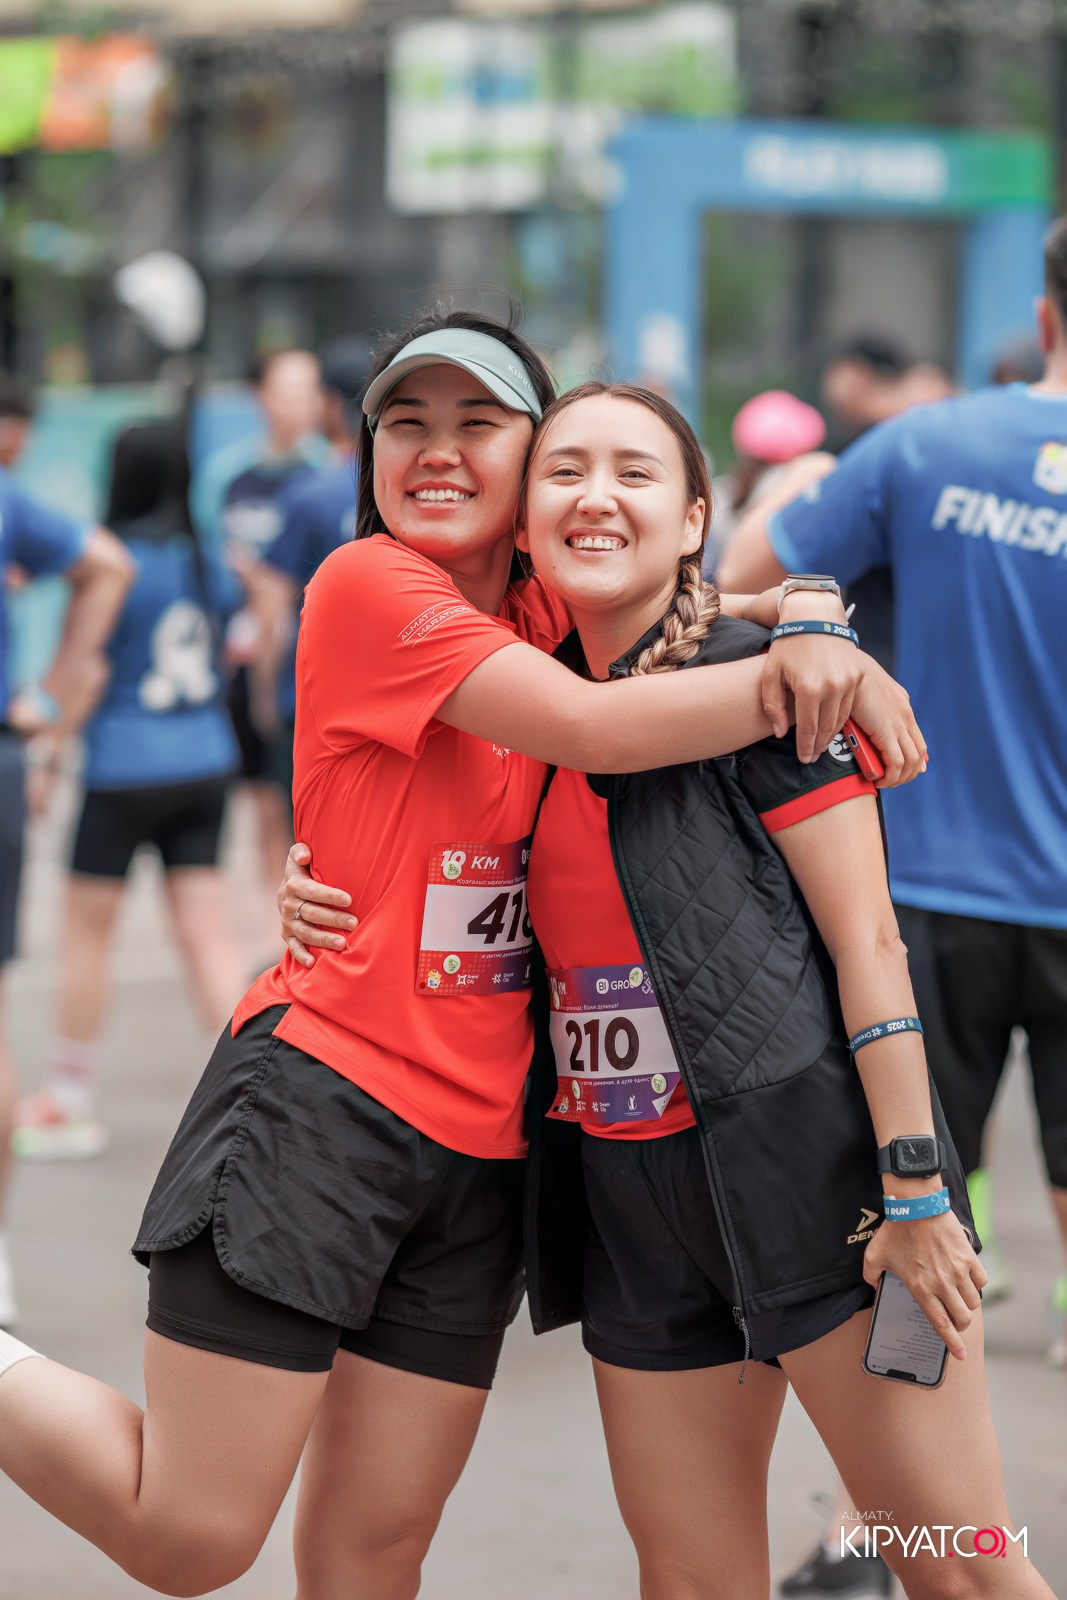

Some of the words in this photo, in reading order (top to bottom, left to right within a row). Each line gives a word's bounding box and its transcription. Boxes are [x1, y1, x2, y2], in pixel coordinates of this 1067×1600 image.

[401, 608, 437, 642] ALMATY
[417, 605, 471, 638] MARATHON
[833, 625, 851, 637] 2025
[470, 856, 500, 870] KM
[610, 979, 635, 990] GRO
[886, 1019, 907, 1033] 2025
[565, 1016, 640, 1071] 210
[890, 1206, 910, 1216] RUN
